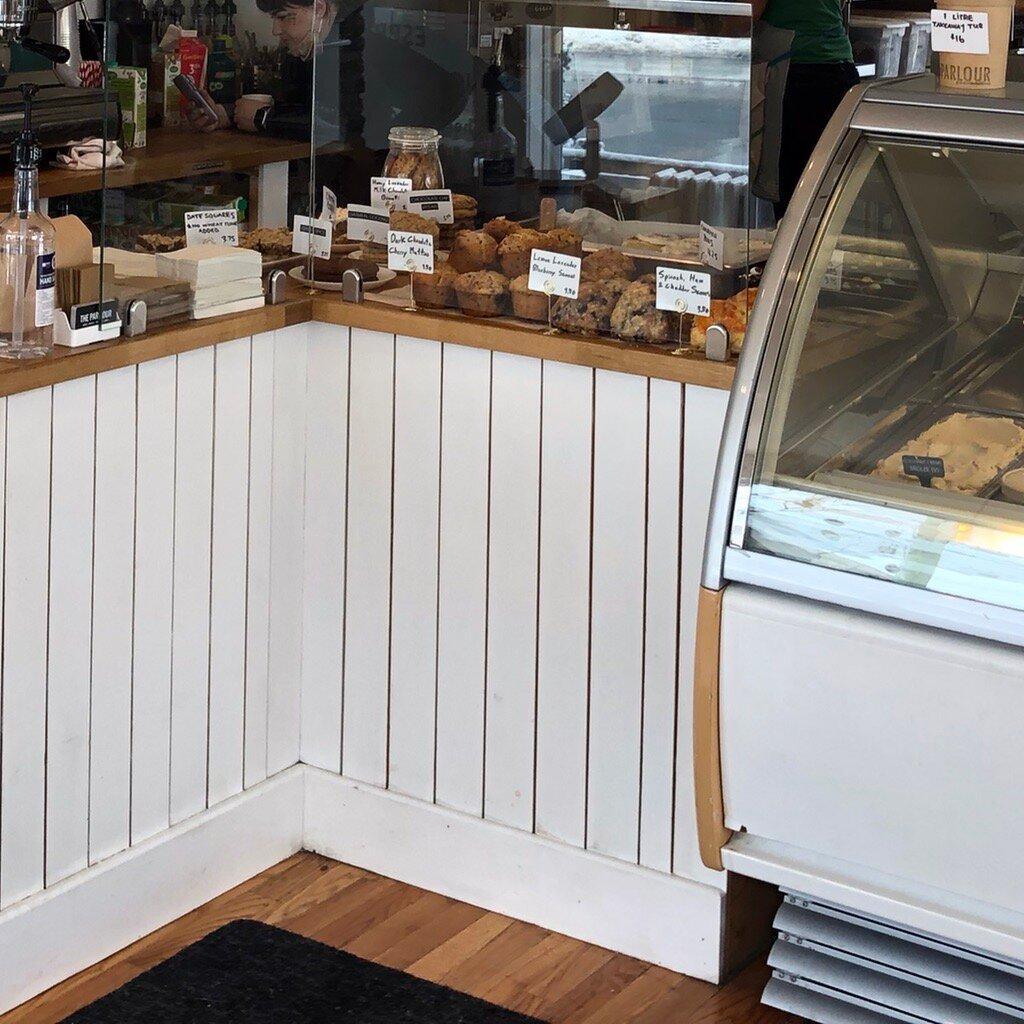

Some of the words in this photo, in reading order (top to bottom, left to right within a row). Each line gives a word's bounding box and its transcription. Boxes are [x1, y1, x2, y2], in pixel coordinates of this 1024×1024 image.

[950, 33, 965, 44] $16
[204, 211, 235, 219] SQUARES
[390, 233, 406, 244] Dark
[388, 247, 408, 258] Cherry
[533, 253, 551, 263] Lemon
[552, 256, 577, 269] Lavender
[689, 273, 704, 283] Ham
[79, 313, 89, 324] THE
[89, 308, 113, 322] PAROUR
